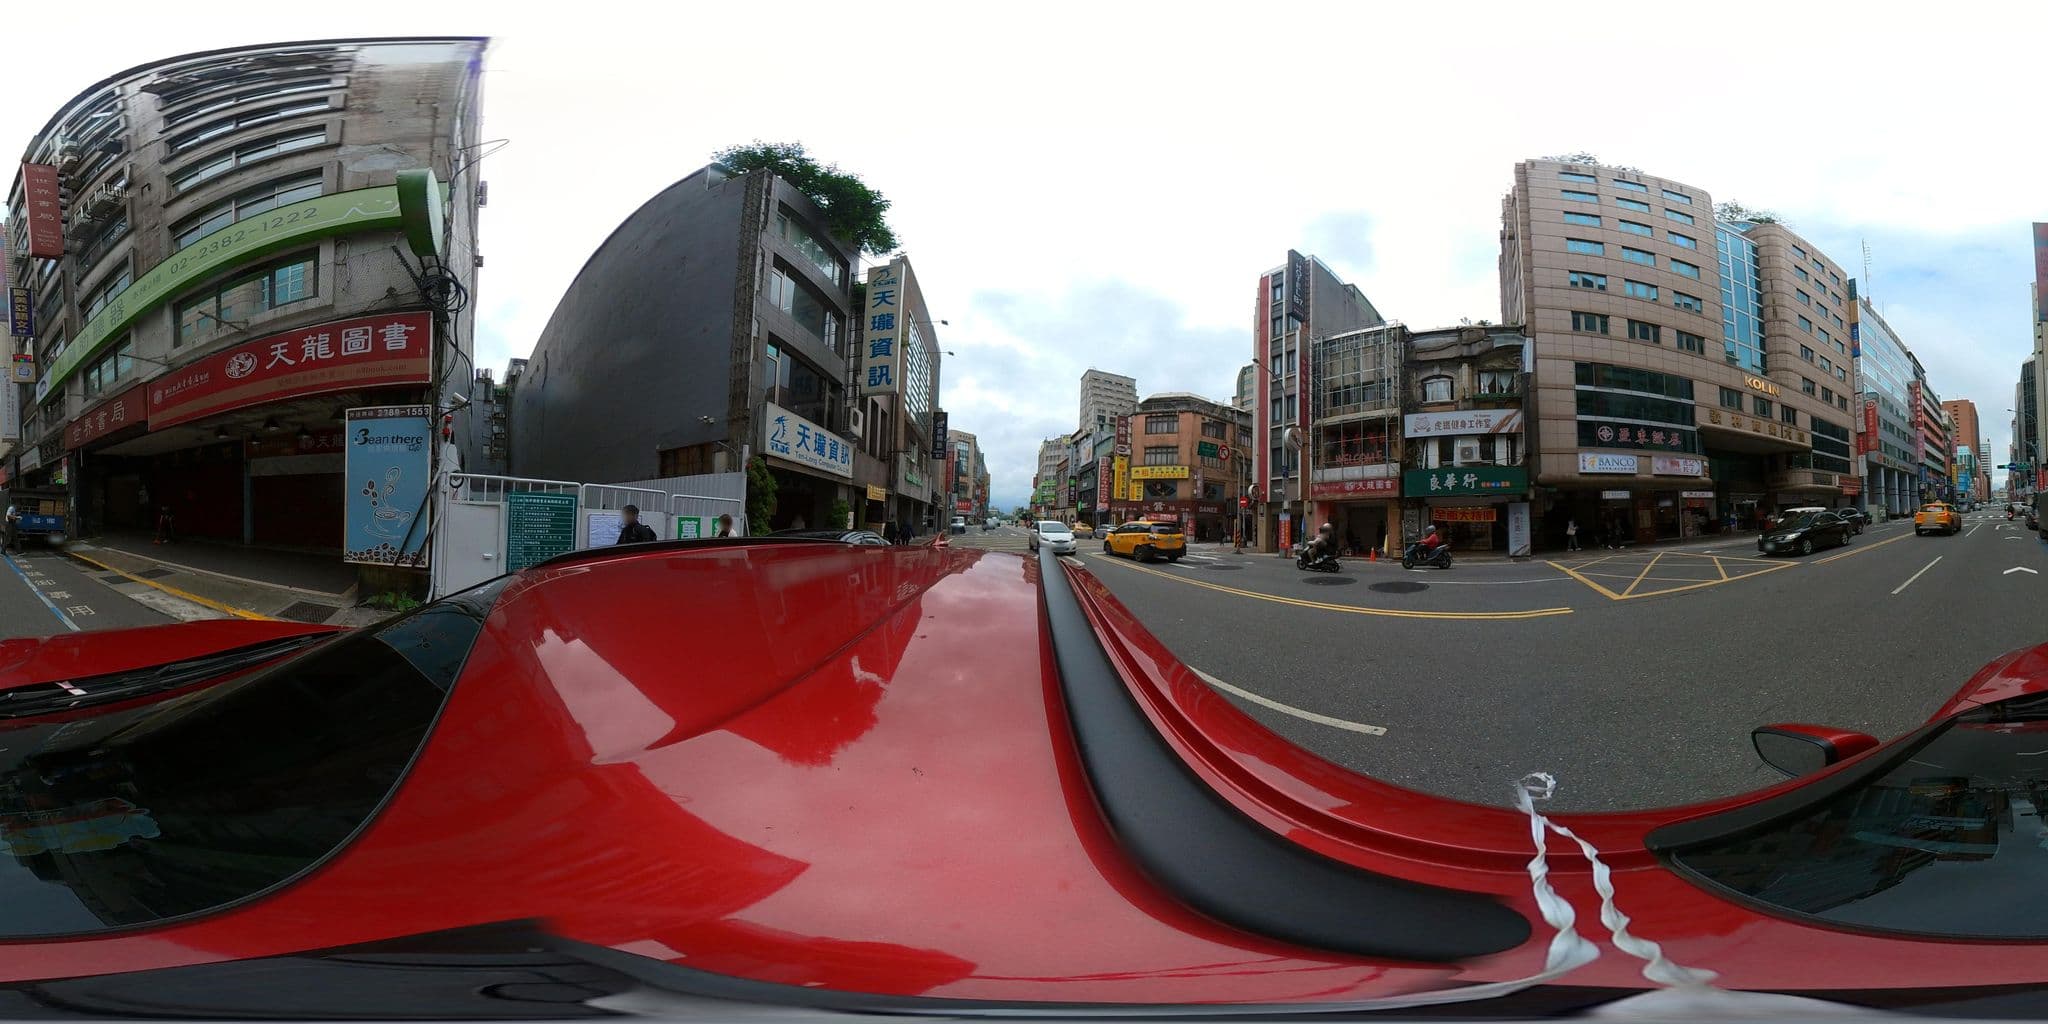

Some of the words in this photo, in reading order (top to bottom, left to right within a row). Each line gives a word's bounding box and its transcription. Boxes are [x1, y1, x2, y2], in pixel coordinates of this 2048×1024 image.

[170, 207, 318, 274] 02-2382-1222
[265, 322, 417, 370] 天龍圖書
[867, 290, 895, 387] 天瓏資訊
[1744, 375, 1781, 397] KOLIN
[72, 400, 125, 442] 世界書局
[391, 434, 423, 444] there
[796, 423, 850, 465] 天瓏資訊
[1335, 449, 1383, 465] WELCOME
[1599, 457, 1635, 467] BANCO
[1430, 473, 1478, 491] 良華行
